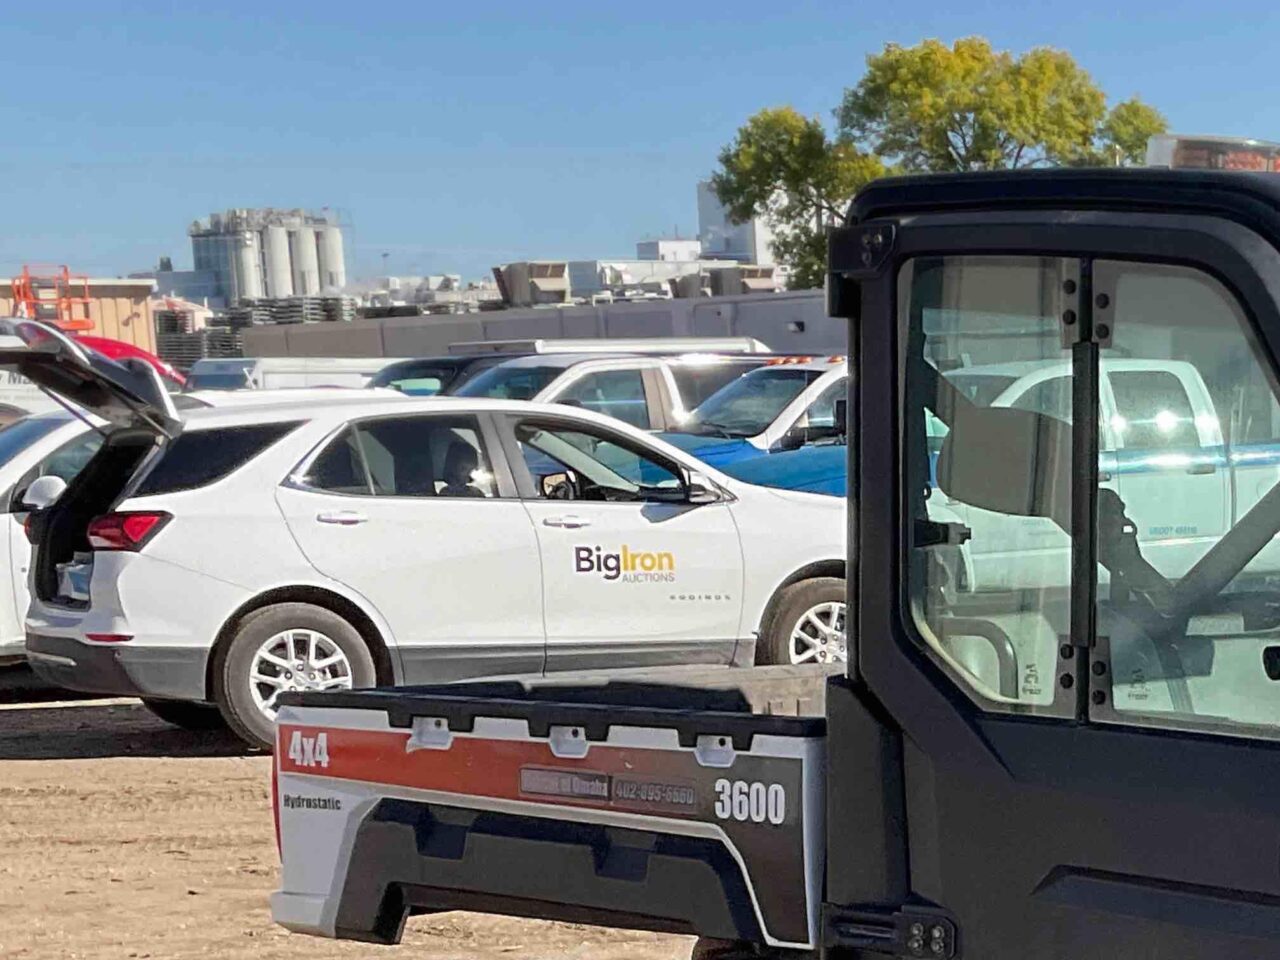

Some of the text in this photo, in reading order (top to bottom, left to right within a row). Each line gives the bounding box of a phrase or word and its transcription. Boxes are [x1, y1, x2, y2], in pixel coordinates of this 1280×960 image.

[575, 545, 674, 580] BigIron
[622, 572, 675, 583] AUCTIONS
[289, 731, 329, 768] 4x4
[283, 794, 341, 810] Hydrostatic
[714, 779, 785, 824] 3600
